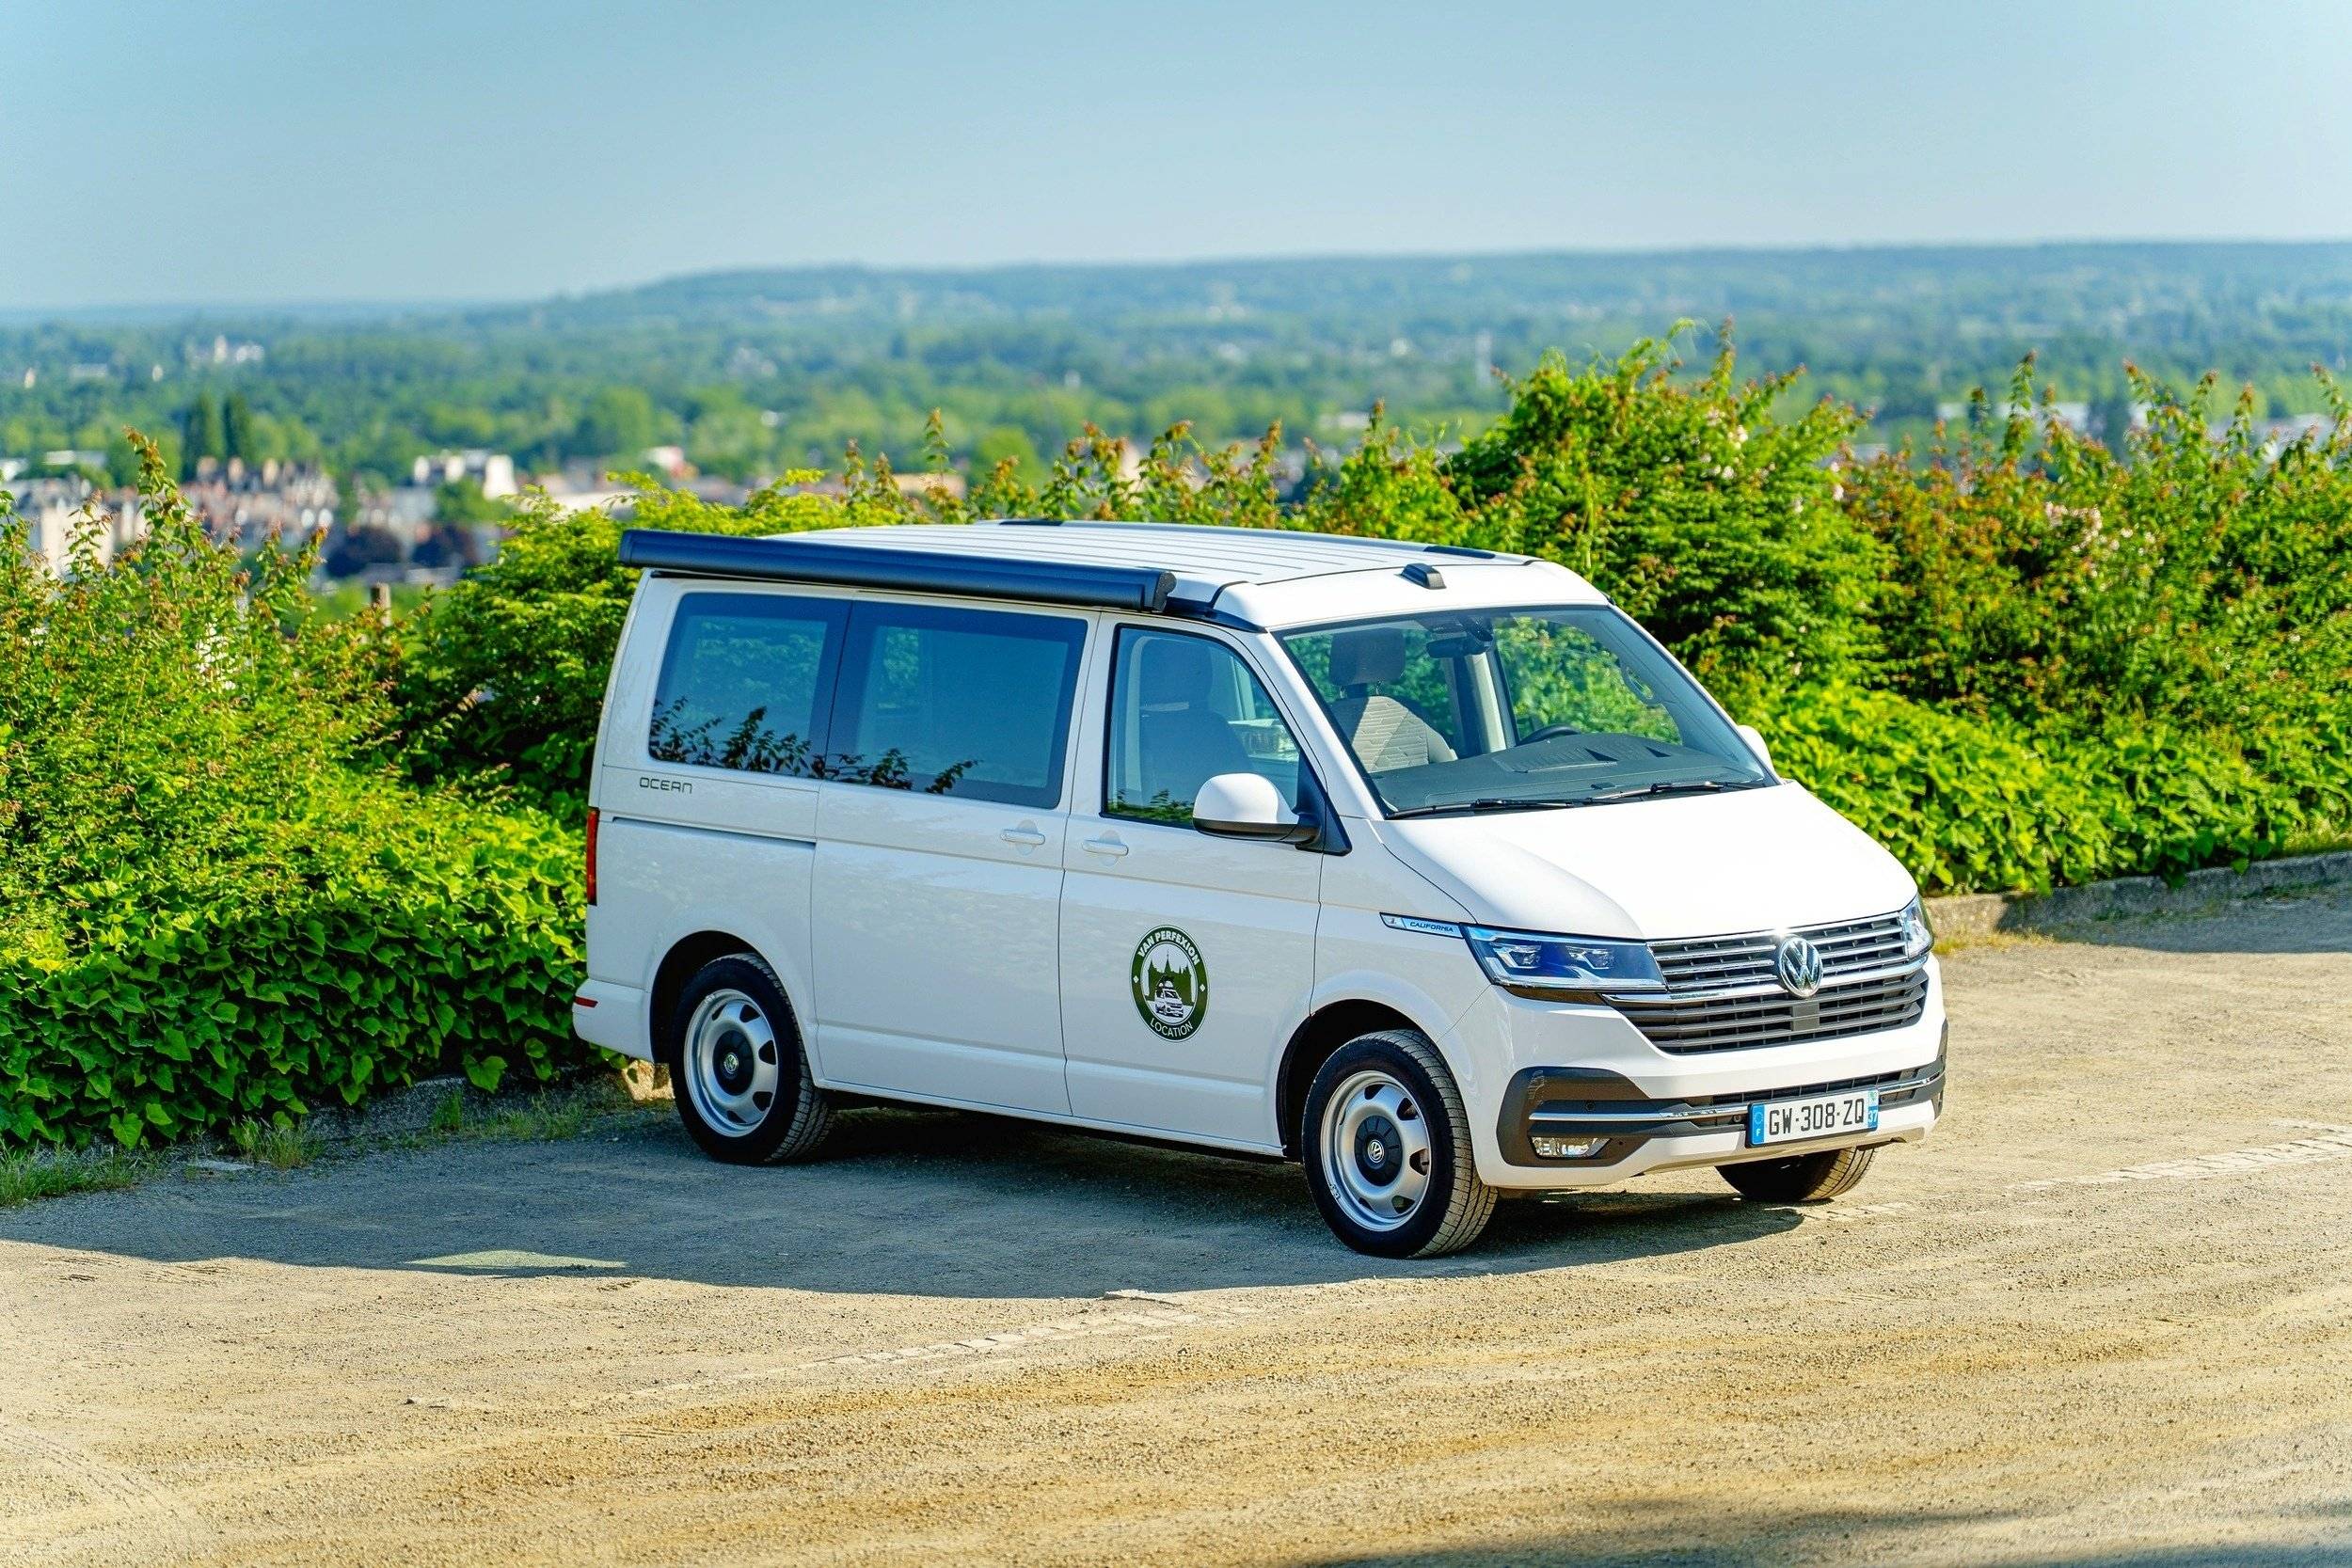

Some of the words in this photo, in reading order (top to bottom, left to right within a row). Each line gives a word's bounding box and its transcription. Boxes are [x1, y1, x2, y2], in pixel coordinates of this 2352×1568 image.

[640, 777, 692, 794] OCEAN
[1409, 921, 1454, 932] CALIFORNIA
[1136, 935, 1156, 958] VAN
[1154, 930, 1200, 965] PERFEXION
[1780, 937, 1821, 995] VW
[1150, 1017, 1193, 1037] LOCATION
[1867, 1109, 1879, 1123] 37
